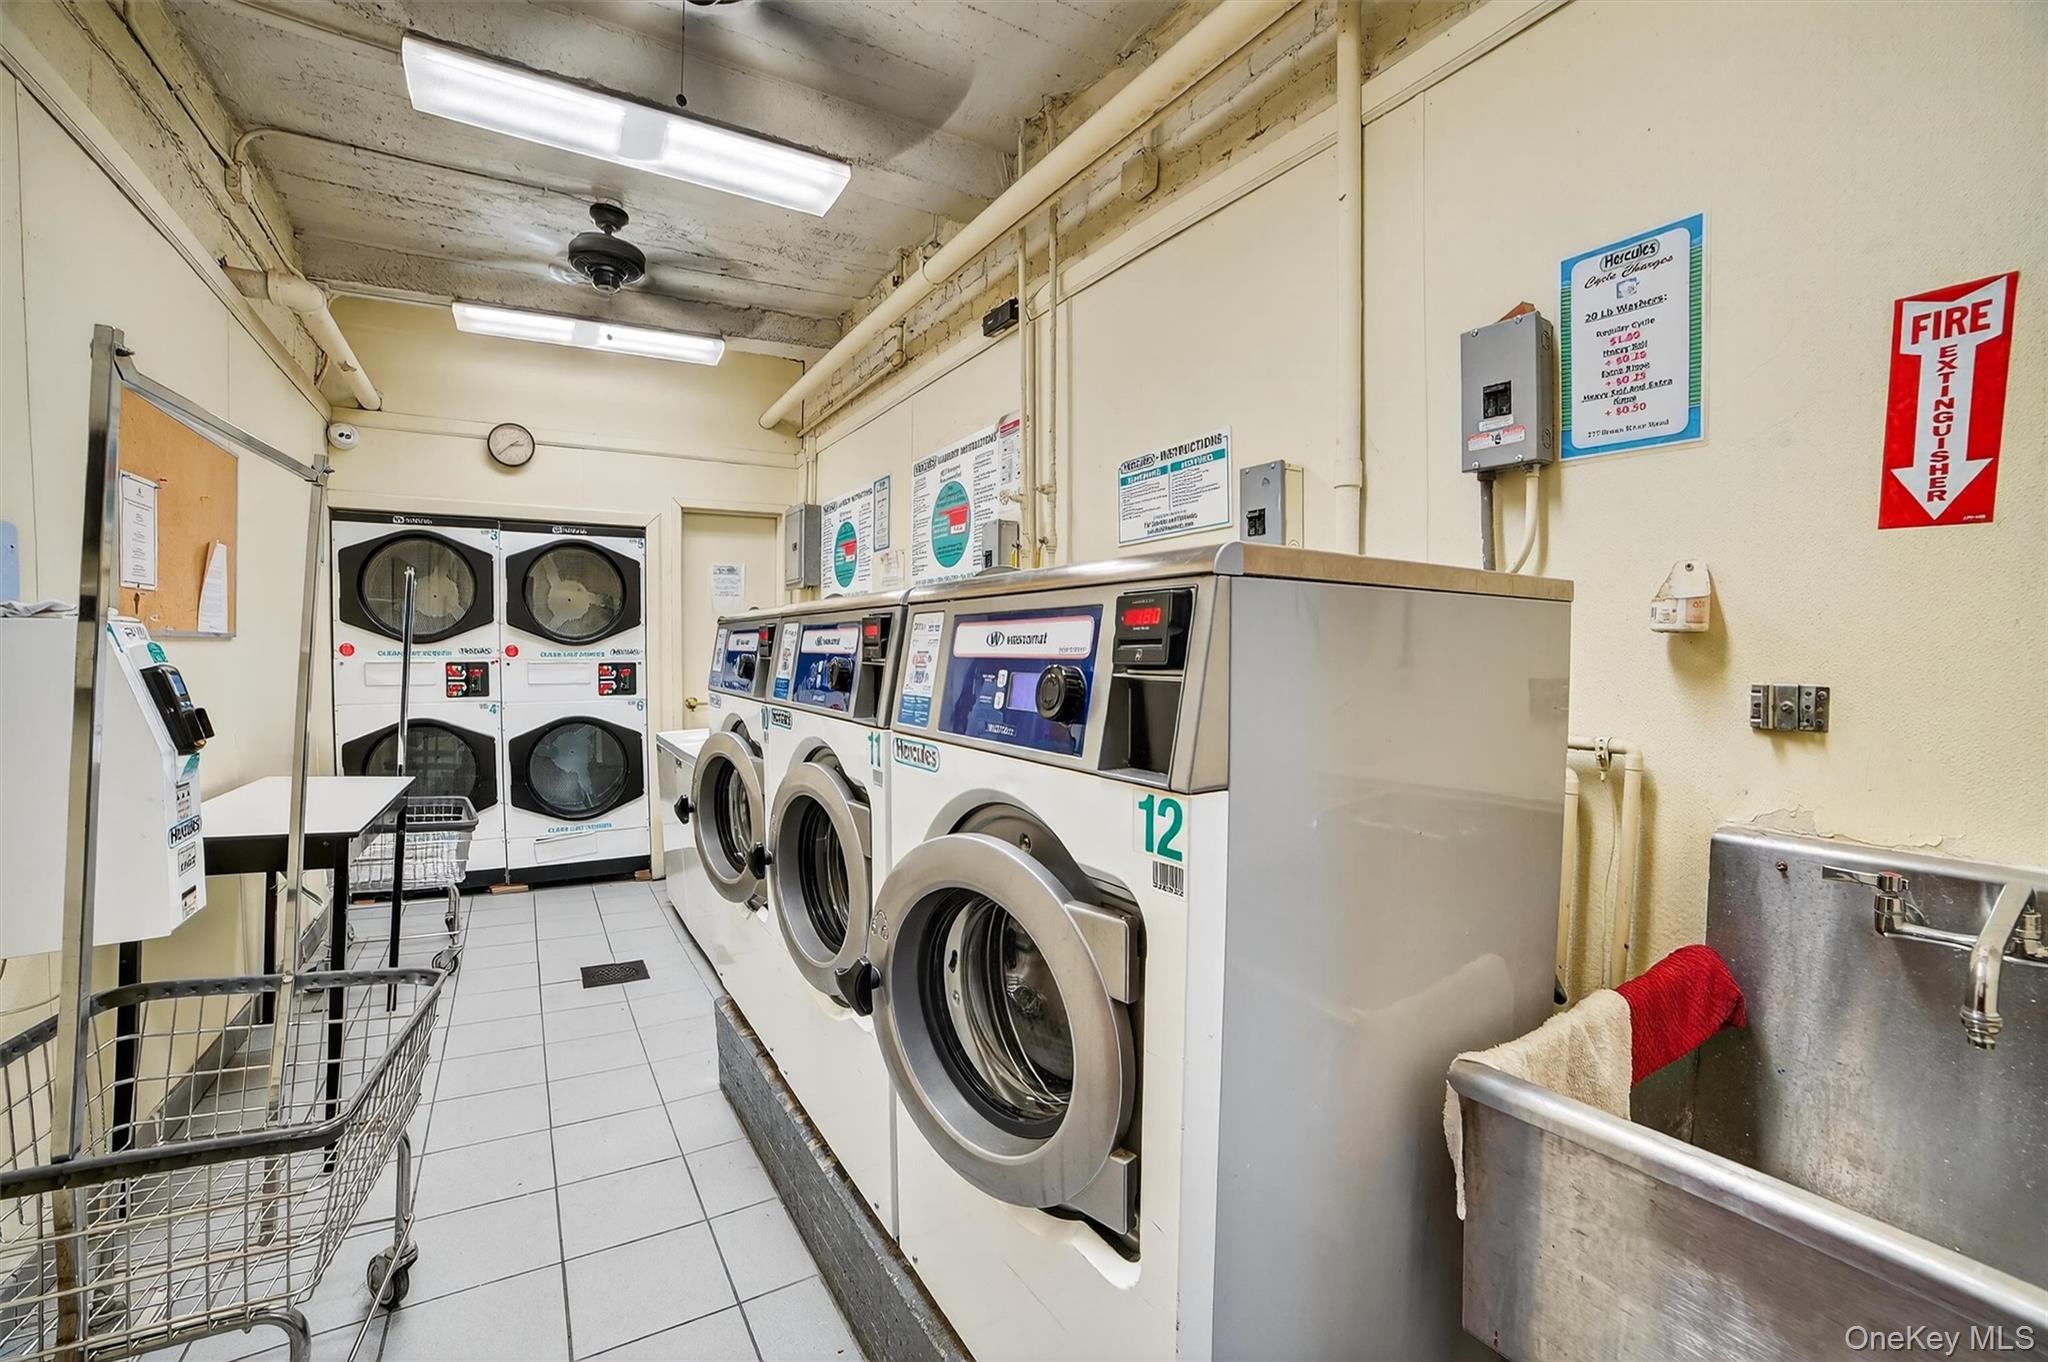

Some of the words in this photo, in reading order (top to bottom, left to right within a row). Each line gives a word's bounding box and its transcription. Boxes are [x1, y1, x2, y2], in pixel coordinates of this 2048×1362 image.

[1584, 272, 1616, 289] Cycle
[1621, 255, 1673, 278] Charges
[1604, 243, 1657, 268] Hercules
[1585, 312, 1598, 323] 20
[1911, 299, 1993, 345] FIRE
[1927, 343, 1958, 502] EXTINGUISHER
[1160, 433, 1222, 461] INSTRUCTIONS
[868, 731, 881, 767] 11
[896, 738, 937, 768] Hercules
[1138, 794, 1184, 862] 12
